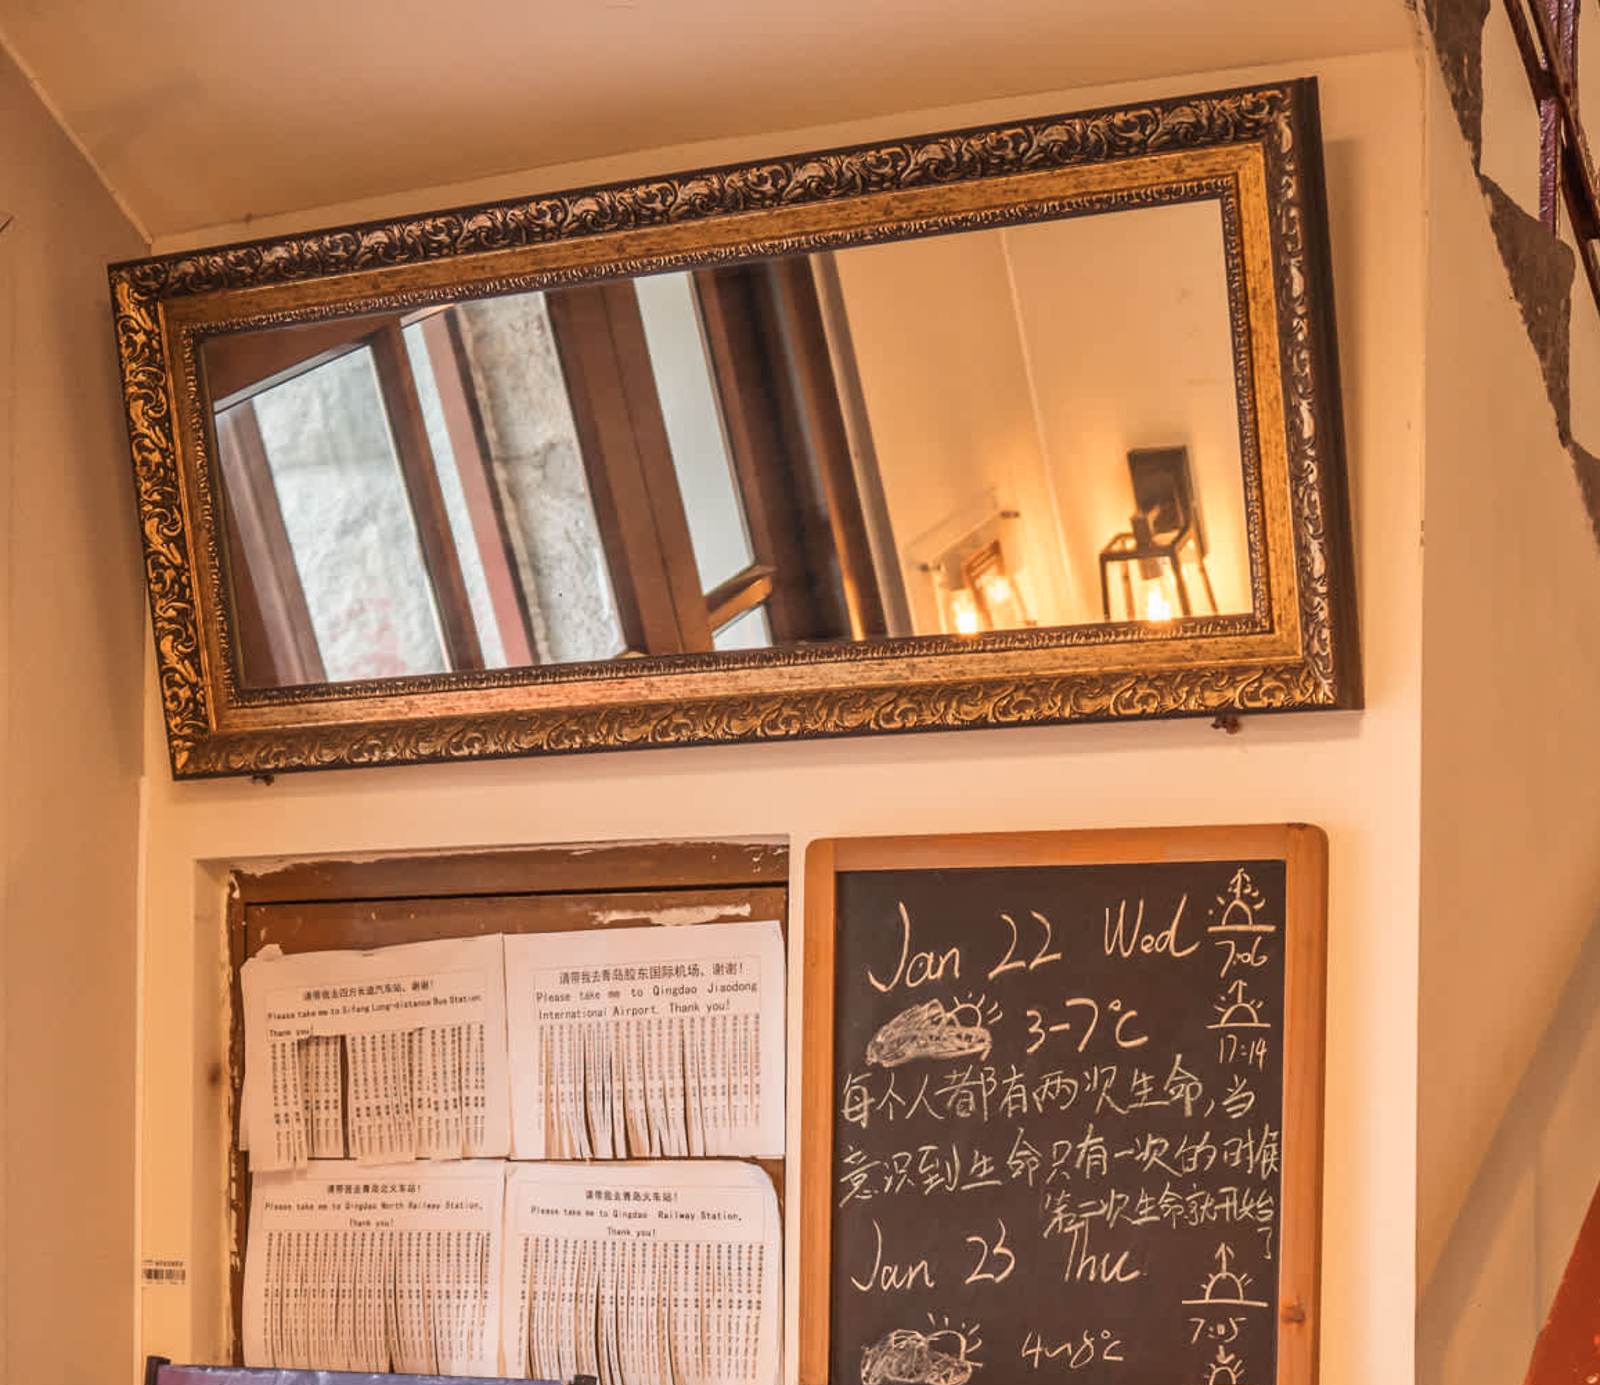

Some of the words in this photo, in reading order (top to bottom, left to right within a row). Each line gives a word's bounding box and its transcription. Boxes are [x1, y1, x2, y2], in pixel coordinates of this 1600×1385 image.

[867, 901, 961, 993] Jan
[987, 909, 1062, 980] 22
[1104, 894, 1201, 957] Wed
[536, 991, 571, 1003] Please
[579, 990, 601, 1001] take
[608, 991, 621, 999] me
[631, 988, 644, 998] to
[652, 985, 697, 998] Qingdao
[706, 982, 758, 996] Jiaodong
[538, 1007, 608, 1021] International
[669, 1001, 700, 1014] Thank
[706, 999, 731, 1013] you!
[1218, 1034, 1268, 1069] 17:14
[531, 1206, 559, 1216] Please
[612, 1209, 648, 1220] Qingdao
[657, 1210, 696, 1221] Railway
[607, 1227, 631, 1237] Thank
[850, 1218, 935, 1293] Jan
[964, 1218, 1016, 1286] 23
